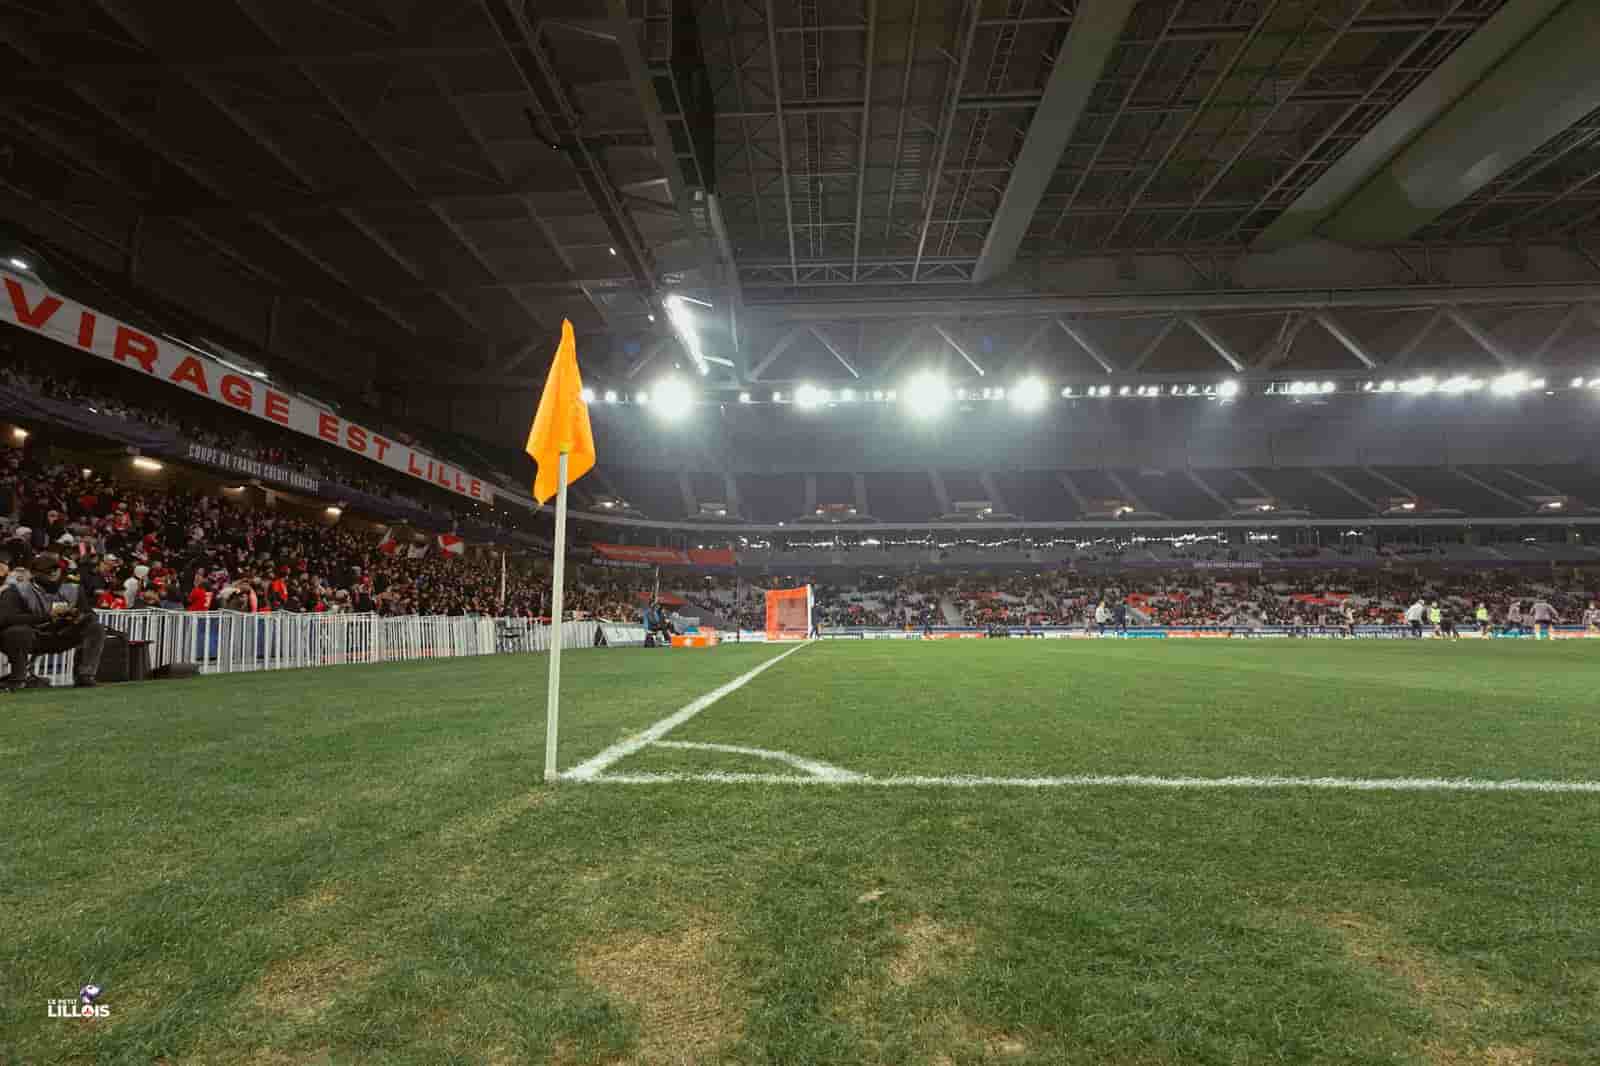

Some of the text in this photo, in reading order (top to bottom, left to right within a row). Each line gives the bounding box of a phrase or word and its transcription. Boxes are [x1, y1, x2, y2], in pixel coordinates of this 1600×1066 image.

[4, 278, 482, 498] VIRAGE EST LILLE
[189, 445, 217, 464] COUPE
[220, 453, 230, 468] DE
[233, 456, 262, 477] FRANCE
